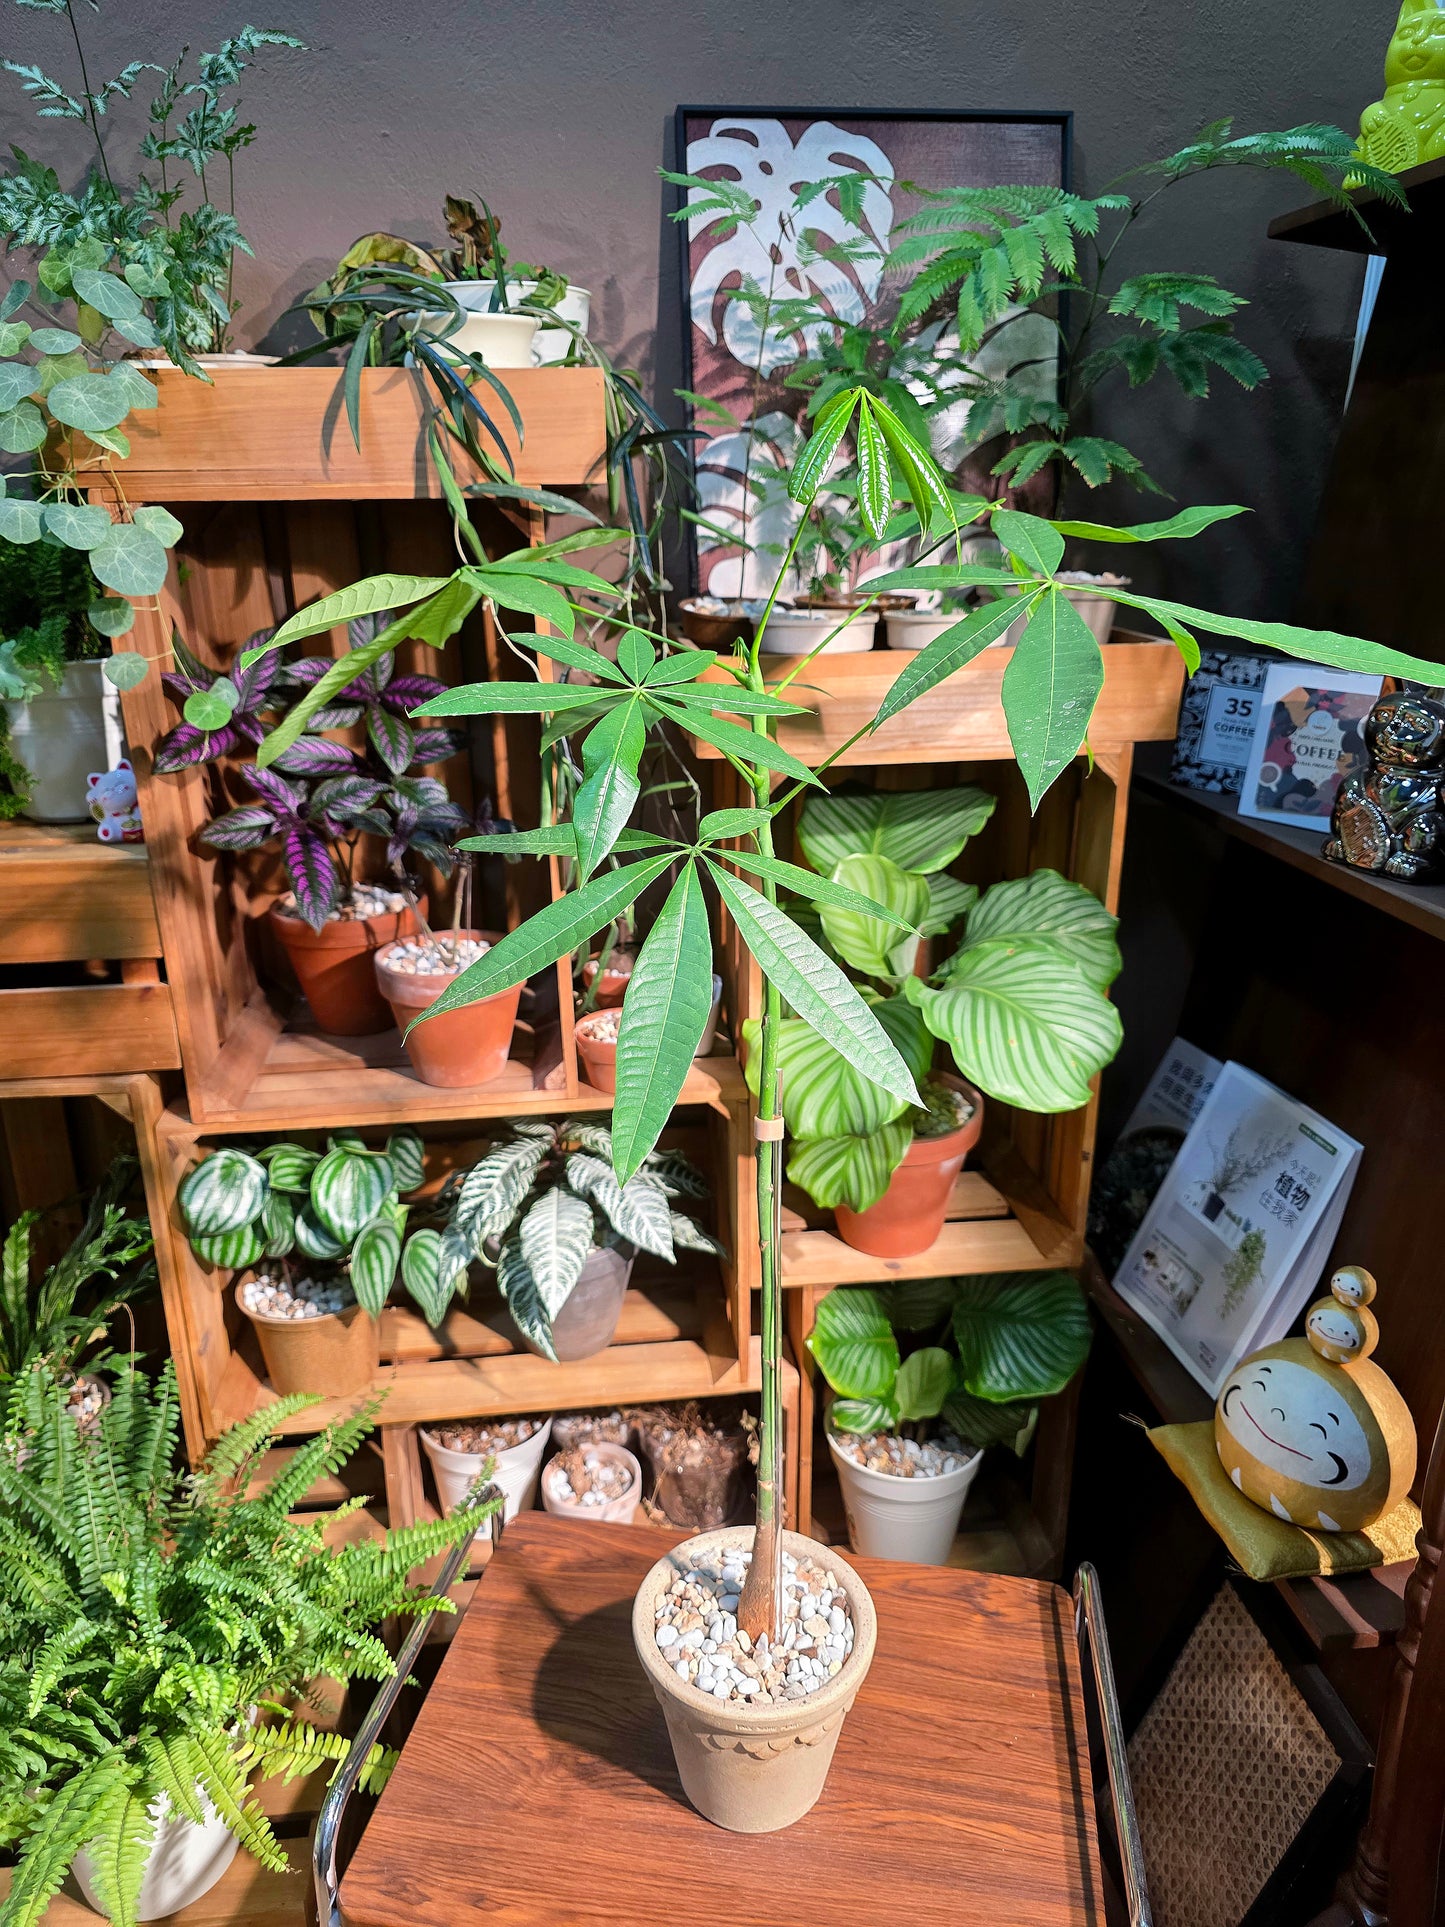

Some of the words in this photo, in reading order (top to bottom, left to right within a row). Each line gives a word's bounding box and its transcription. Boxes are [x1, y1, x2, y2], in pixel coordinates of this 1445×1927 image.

[1224, 698, 1253, 717] 35
[1213, 721, 1256, 738] COFFEE
[1274, 1171, 1312, 1211] 植物
